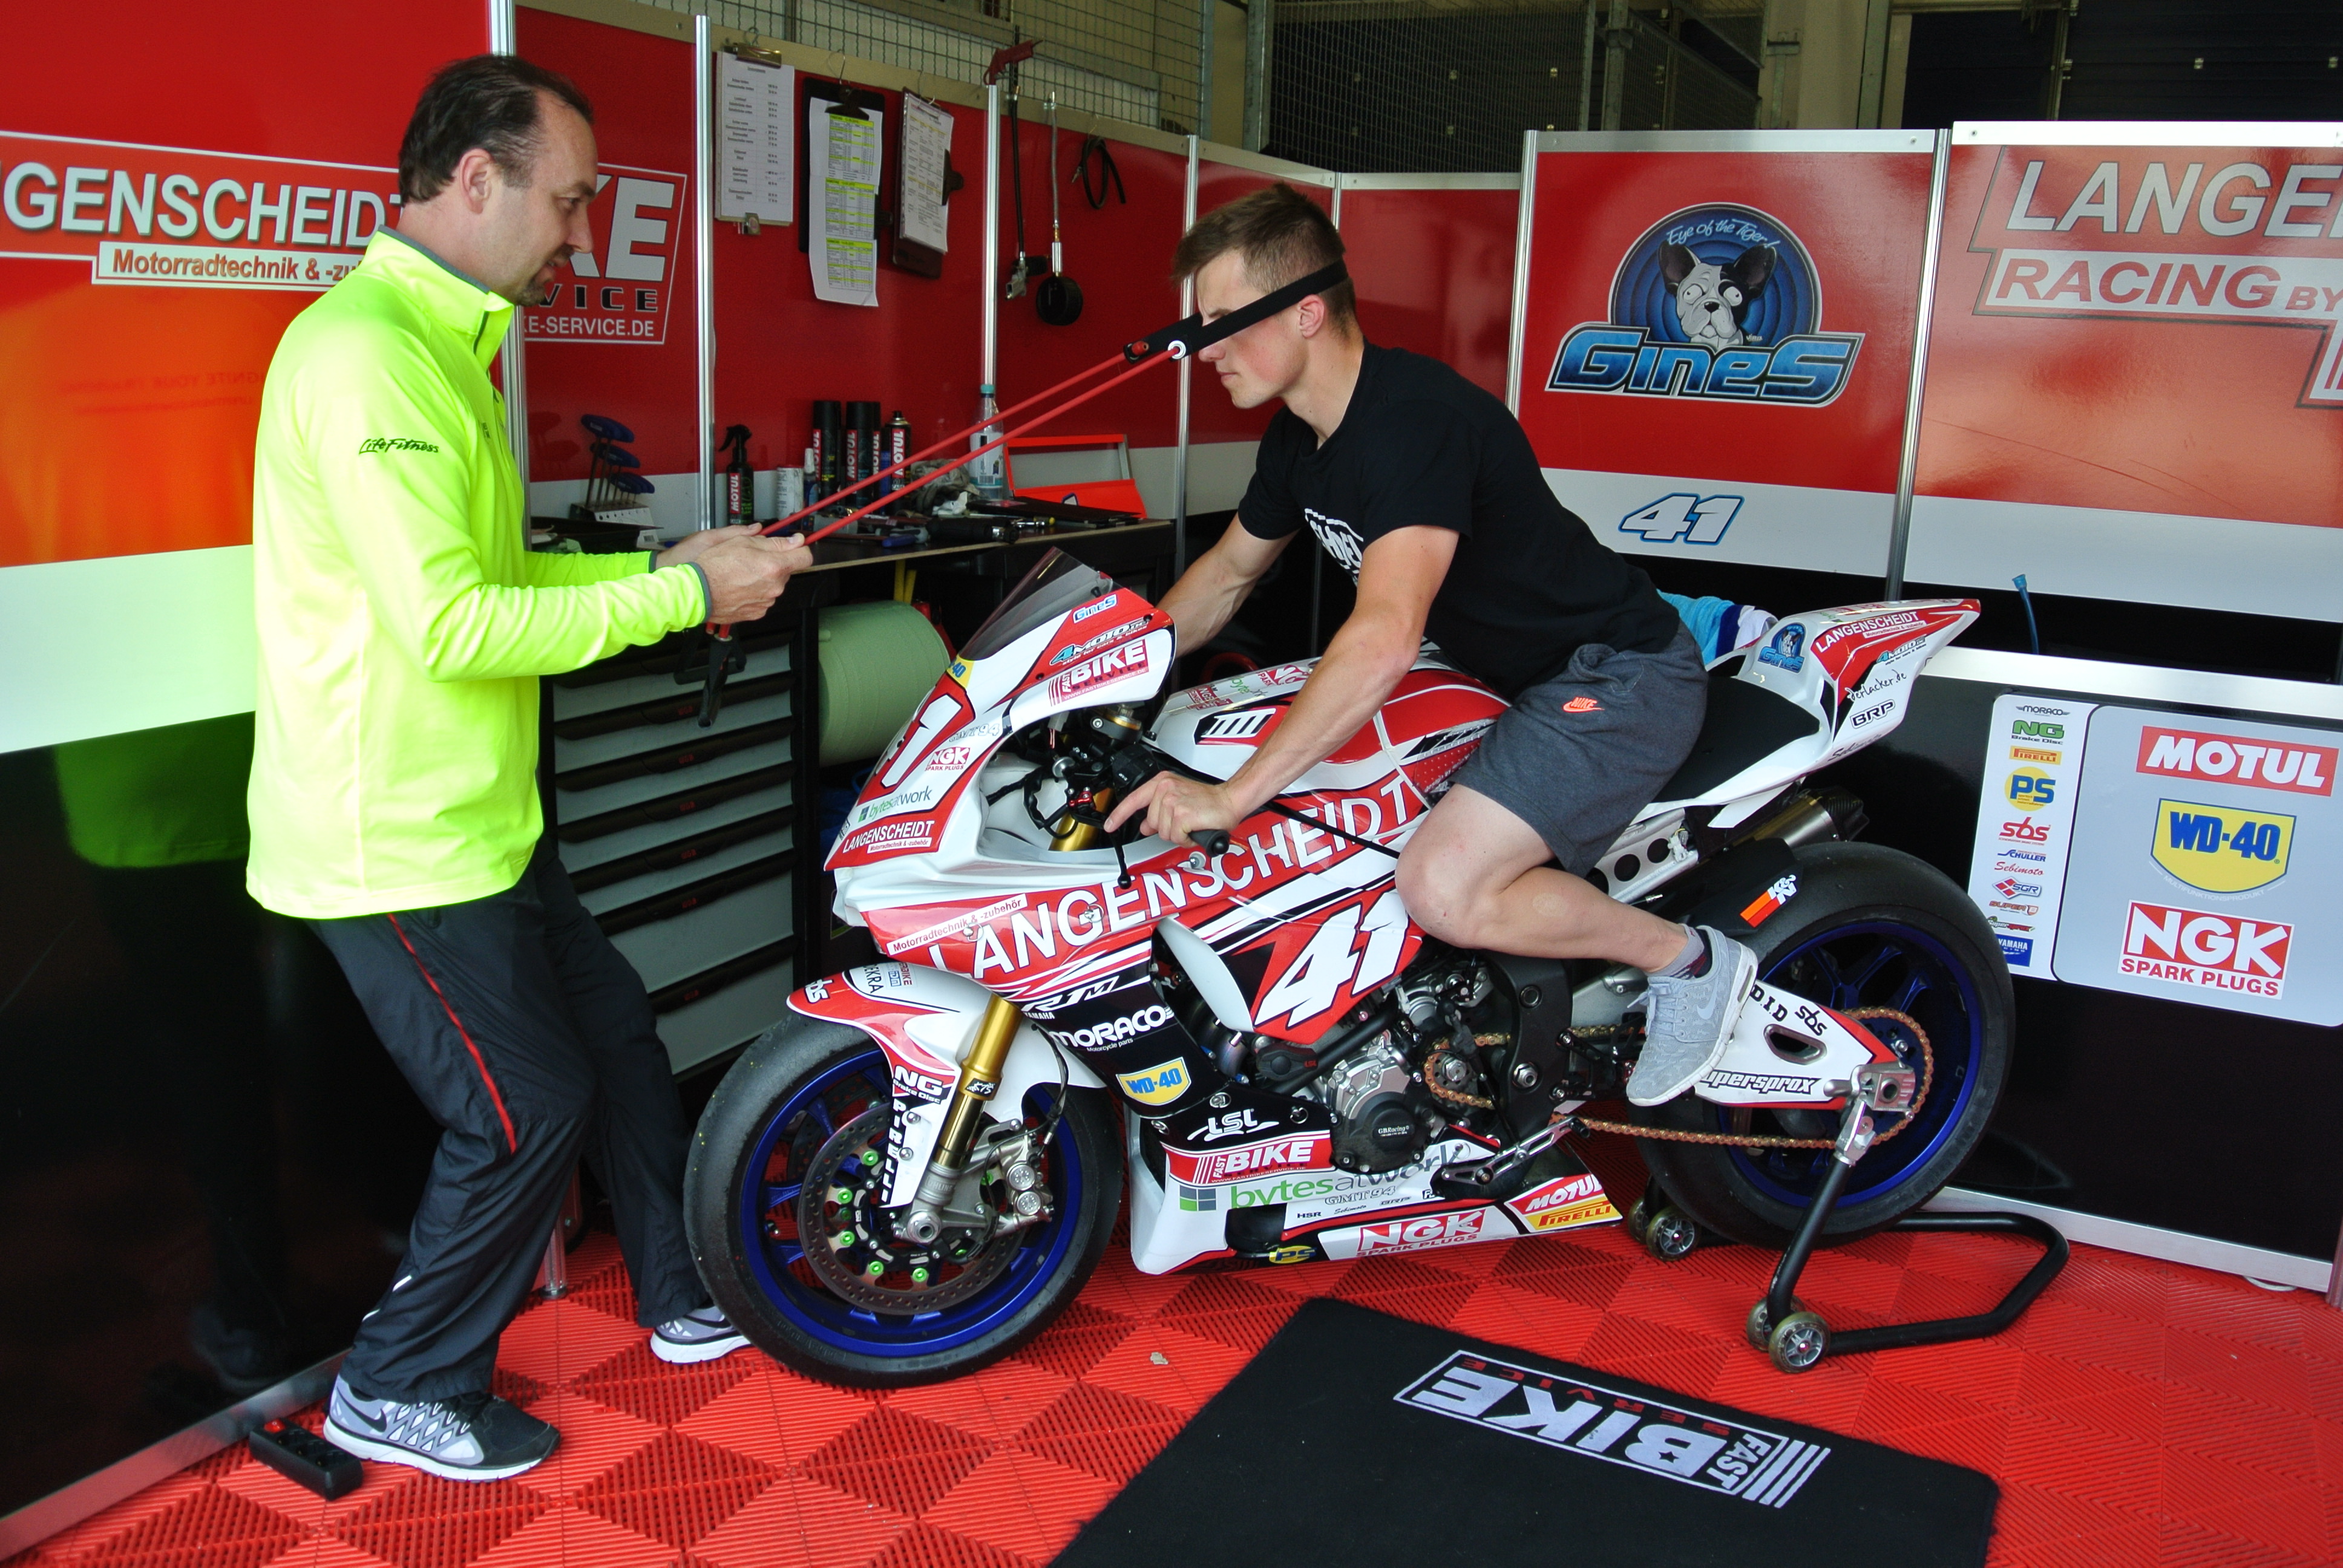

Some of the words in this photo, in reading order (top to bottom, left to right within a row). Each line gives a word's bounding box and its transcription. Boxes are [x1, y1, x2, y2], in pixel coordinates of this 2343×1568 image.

[2005, 160, 2343, 238] LANGE
[1666, 225, 1694, 246] Eye
[1696, 220, 1714, 237] of
[1715, 220, 1735, 233] the
[1732, 219, 1781, 249] Tiger!
[113, 249, 299, 281] Motorradtechnik
[305, 259, 320, 281] &
[1996, 258, 2282, 309] RACING
[1619, 492, 1744, 544] 41
[1815, 612, 1920, 653] LANGENSCHEIDT
[1072, 640, 1146, 685] BIKE
[1062, 674, 1072, 693] FAST
[1845, 668, 1907, 701] derlacker.de
[1570, 697, 1598, 709] NIKE
[1852, 701, 1893, 726] BRP
[2022, 705, 2063, 716] MORACO
[2012, 720, 2065, 739] NG
[930, 748, 970, 765] NGK
[2014, 748, 2057, 762] PIRELLI
[2145, 735, 2327, 788] MOTUL
[2010, 774, 2056, 803] PS
[843, 820, 935, 853] LANGENSCHEIDT
[1999, 817, 2049, 841] sbs
[2170, 811, 2281, 861] WD-40
[928, 774, 1407, 980] LANGENSCHEIDT
[1994, 861, 2043, 875] Sebimoto
[1768, 875, 1797, 905] K&N
[2012, 883, 2039, 893] SGR
[2163, 875, 2266, 902] MULTIFUNKTIONSPRODUKT
[893, 918, 968, 952] Motorradtechnik
[971, 915, 978, 923] &
[980, 900, 1021, 919] -zubehör
[2127, 906, 2288, 978] NGK
[1254, 892, 1409, 1028] 41
[2121, 958, 2195, 983] SPARK
[2201, 971, 2279, 996] PLUGS
[1049, 1005, 1167, 1047] MORACO
[1087, 1042, 1117, 1052] Motorcycle
[1118, 1037, 1133, 1048] parts
[893, 1079, 917, 1097] Brake
[918, 1092, 941, 1104] Disc
[894, 1065, 943, 1096] NG
[1127, 1068, 1182, 1094] WD-40
[1702, 1071, 1816, 1094] upersprox
[1208, 1109, 1258, 1135] LSL
[881, 1099, 906, 1203] PIRELLI
[1224, 1141, 1314, 1174] BIKE
[1213, 1156, 1228, 1178] FAST
[1525, 1174, 1603, 1212] MOTUL
[1538, 1200, 1611, 1227] PIRELLI
[1357, 1243, 1414, 1256] SPARK
[1418, 1234, 1478, 1250] PLUGS
[1360, 1211, 1483, 1251] NGK
[1276, 1247, 1317, 1261] PS
[1412, 1367, 1727, 1478] BIKE
[1706, 1434, 1771, 1490] FAST
